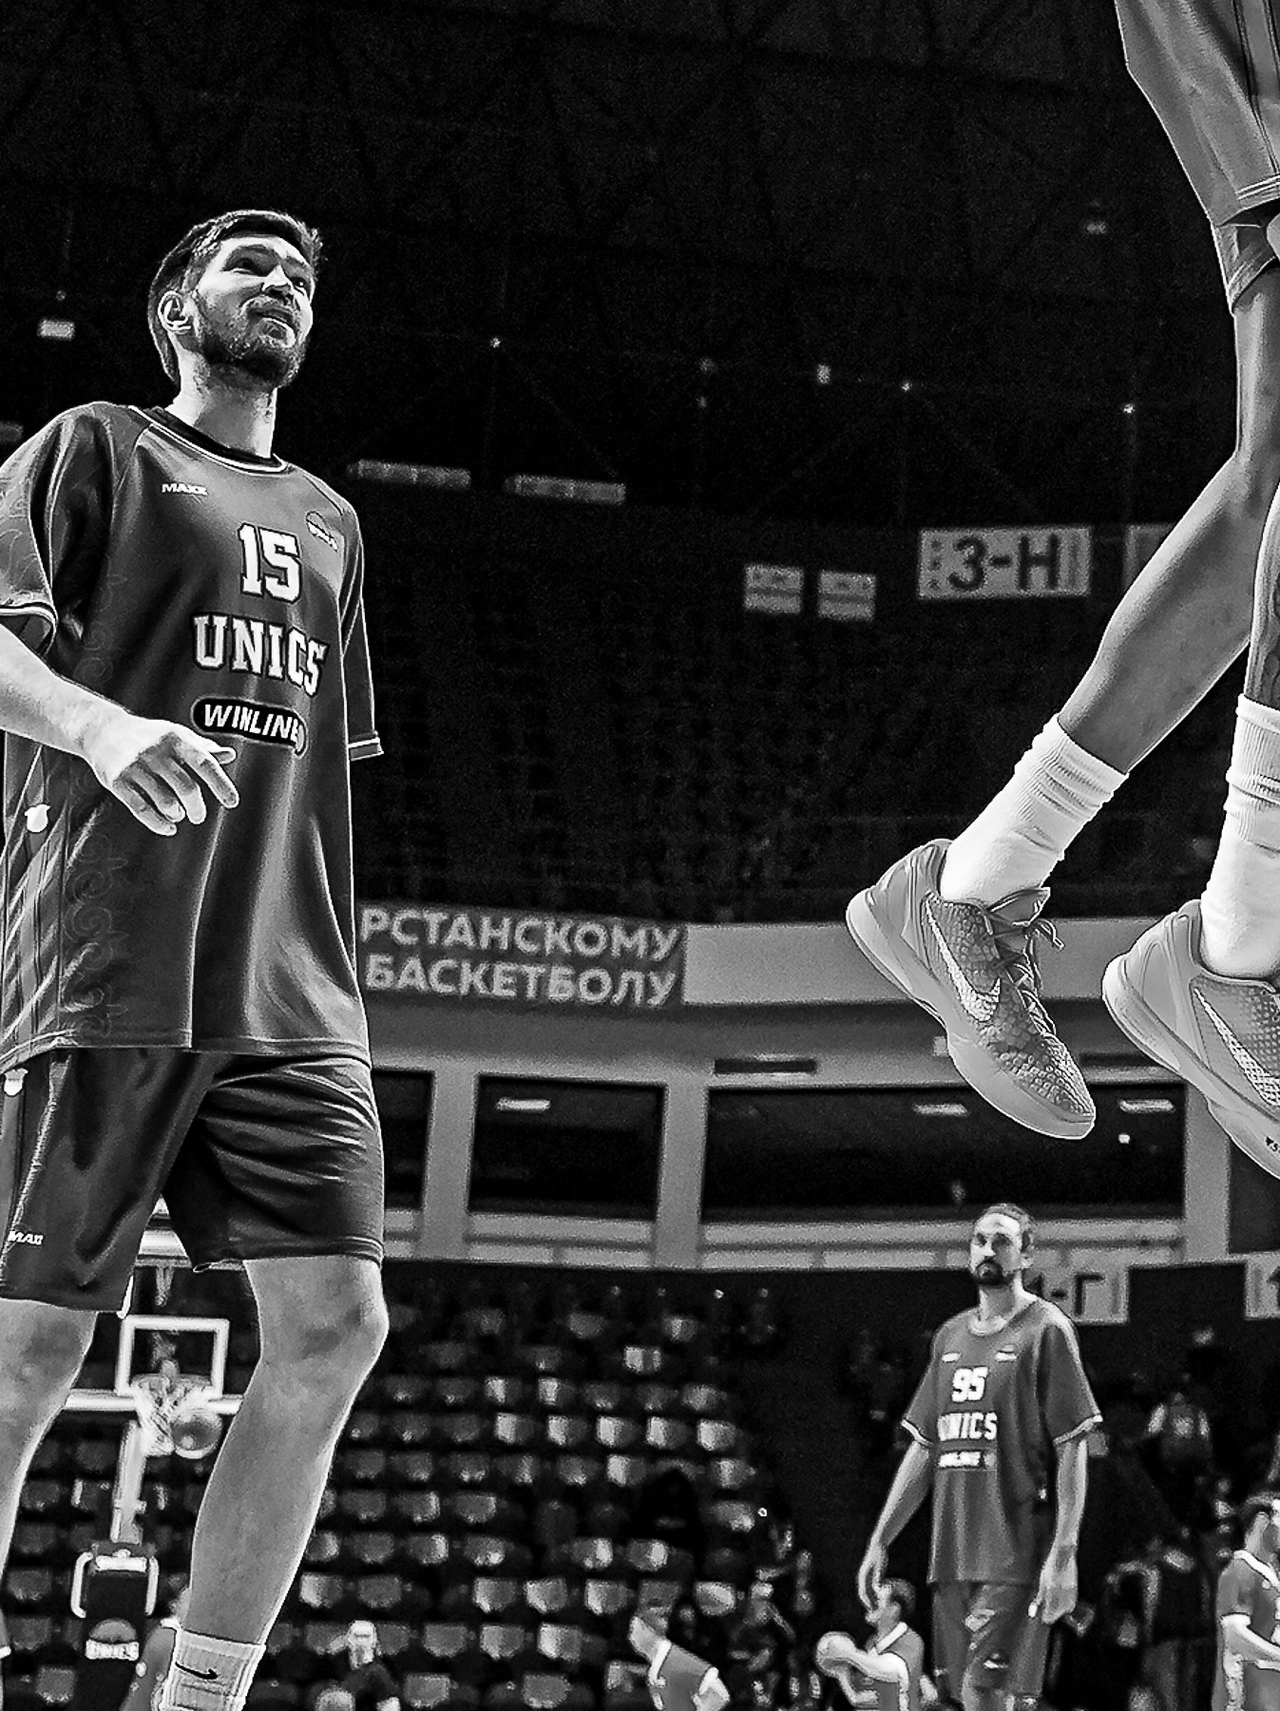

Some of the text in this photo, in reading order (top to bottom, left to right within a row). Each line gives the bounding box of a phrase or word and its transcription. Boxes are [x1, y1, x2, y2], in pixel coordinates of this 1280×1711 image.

[238, 521, 301, 604] 15
[193, 614, 329, 696] UNICS
[360, 907, 682, 963] РСТАНСКОМУ
[365, 953, 677, 1007] БАСКЕТБОЛУ
[951, 1366, 989, 1403] 95
